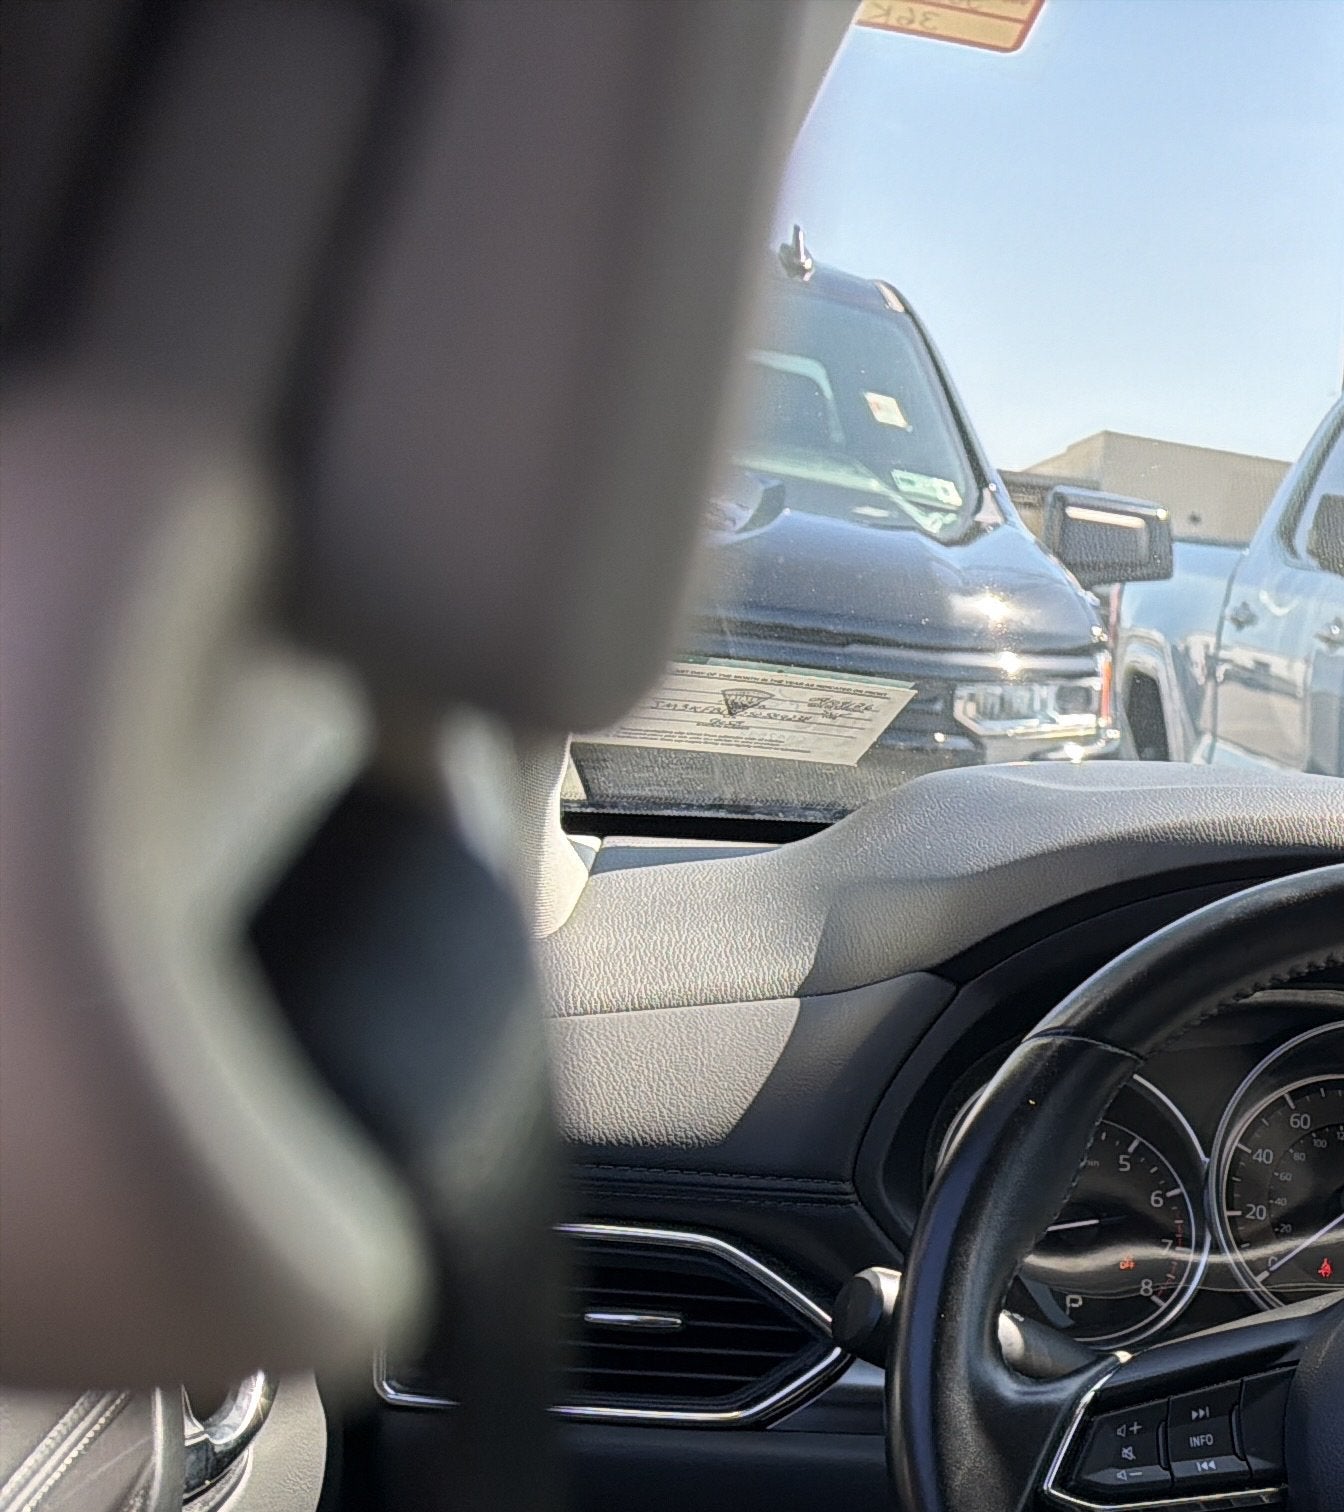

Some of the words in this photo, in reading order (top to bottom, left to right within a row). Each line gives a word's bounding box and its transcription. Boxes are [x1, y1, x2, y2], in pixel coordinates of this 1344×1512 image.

[1289, 1113, 1311, 1130] 60
[1312, 1139, 1327, 1149] 100
[1119, 1155, 1131, 1172] 5
[1252, 1149, 1274, 1165] 40
[1294, 1152, 1306, 1162] 80
[1279, 1172, 1292, 1182] 60
[1150, 1190, 1164, 1208] 6
[1245, 1204, 1267, 1221] 20
[1280, 1223, 1292, 1234] 20
[1160, 1238, 1173, 1257] 7
[1140, 1278, 1153, 1297] 8
[1189, 1433, 1214, 1448] INFO
